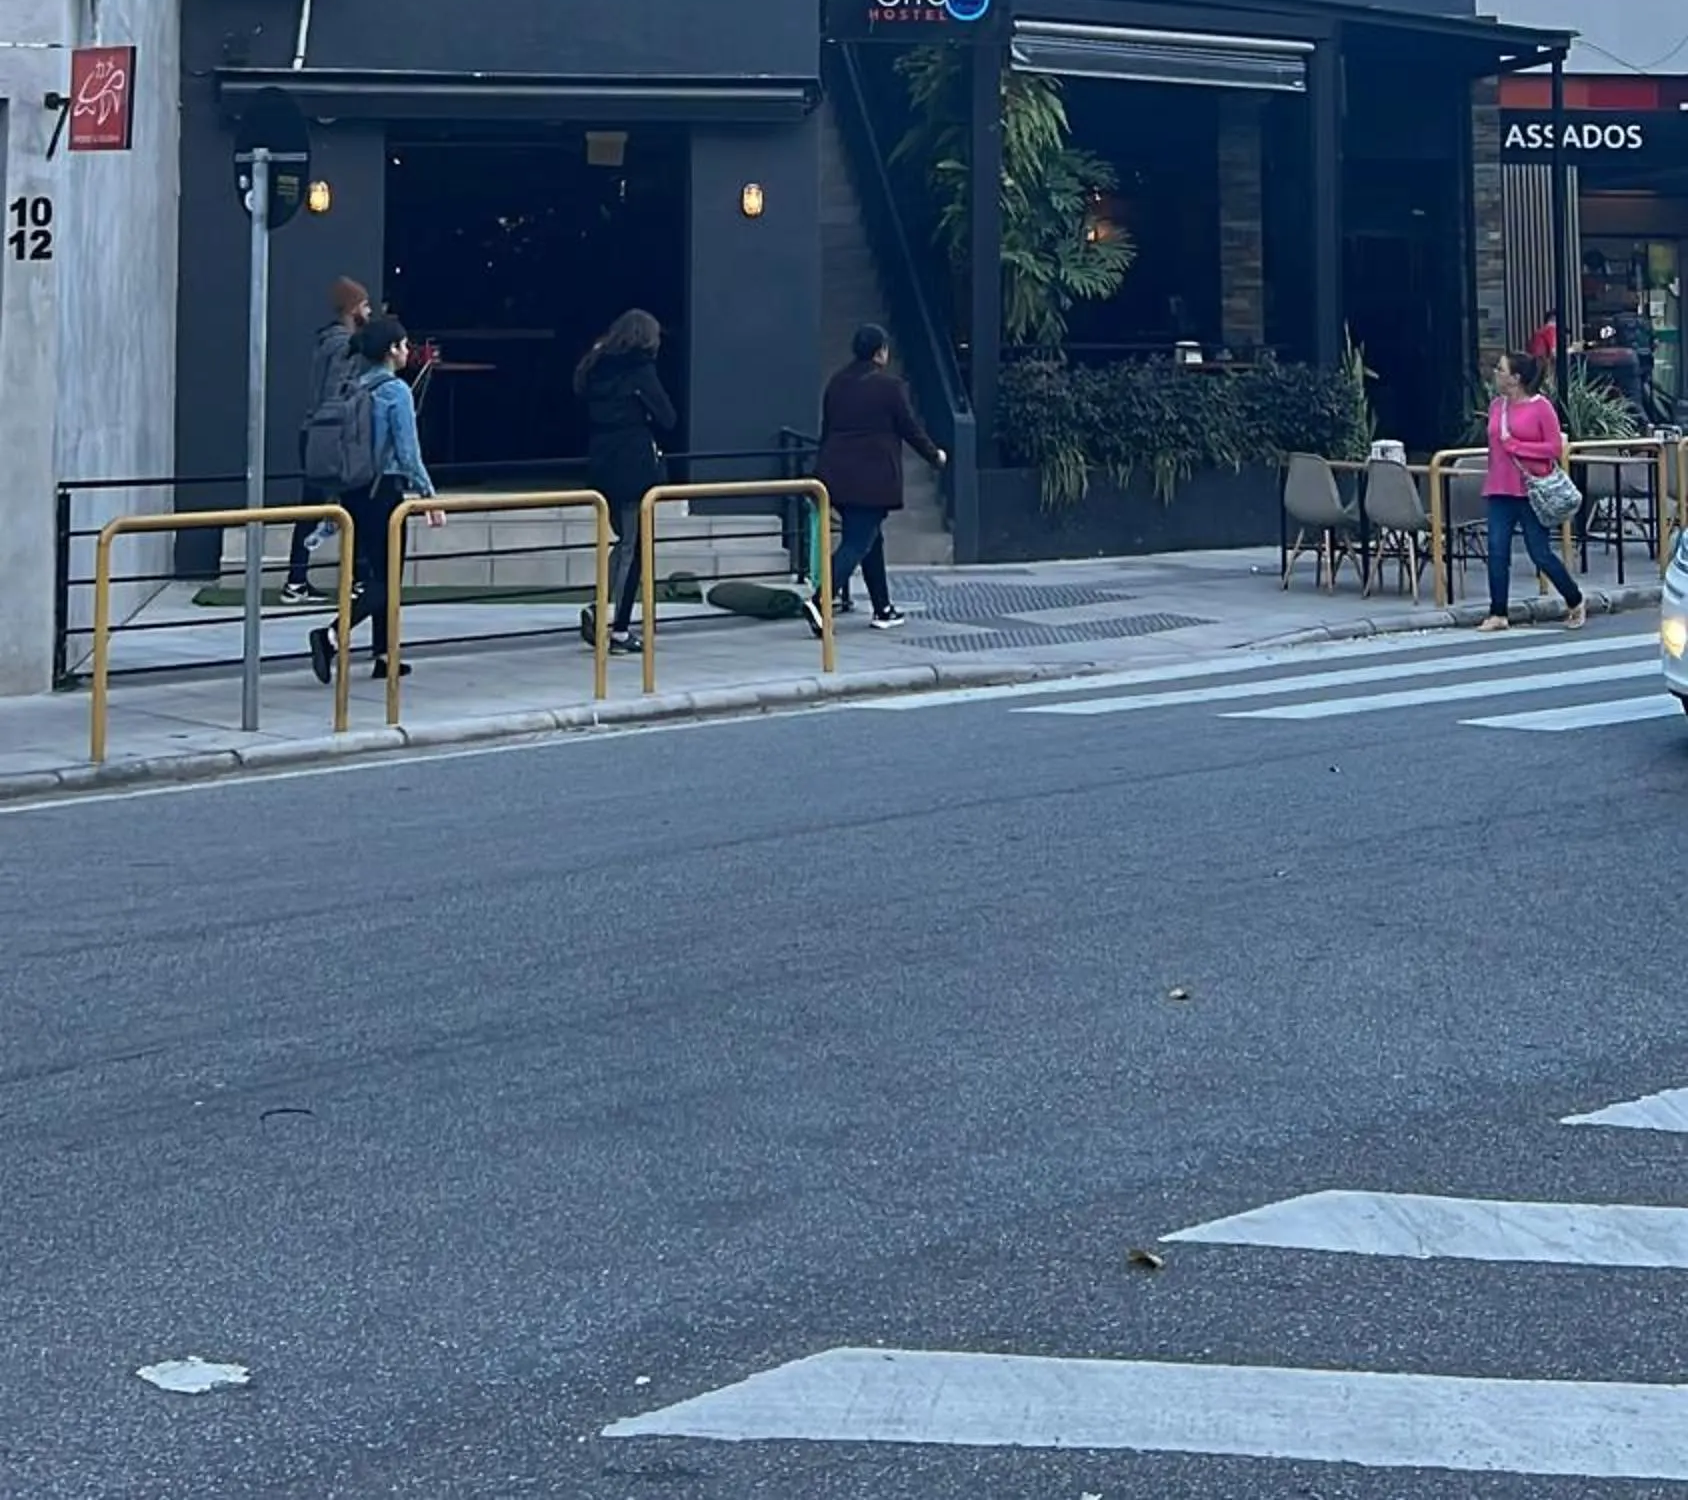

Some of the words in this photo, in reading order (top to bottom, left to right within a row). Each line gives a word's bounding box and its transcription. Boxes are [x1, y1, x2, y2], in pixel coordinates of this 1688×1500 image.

[869, 8, 948, 20] HOSTEL
[9, 197, 52, 227] 10
[8, 230, 52, 260] 12
